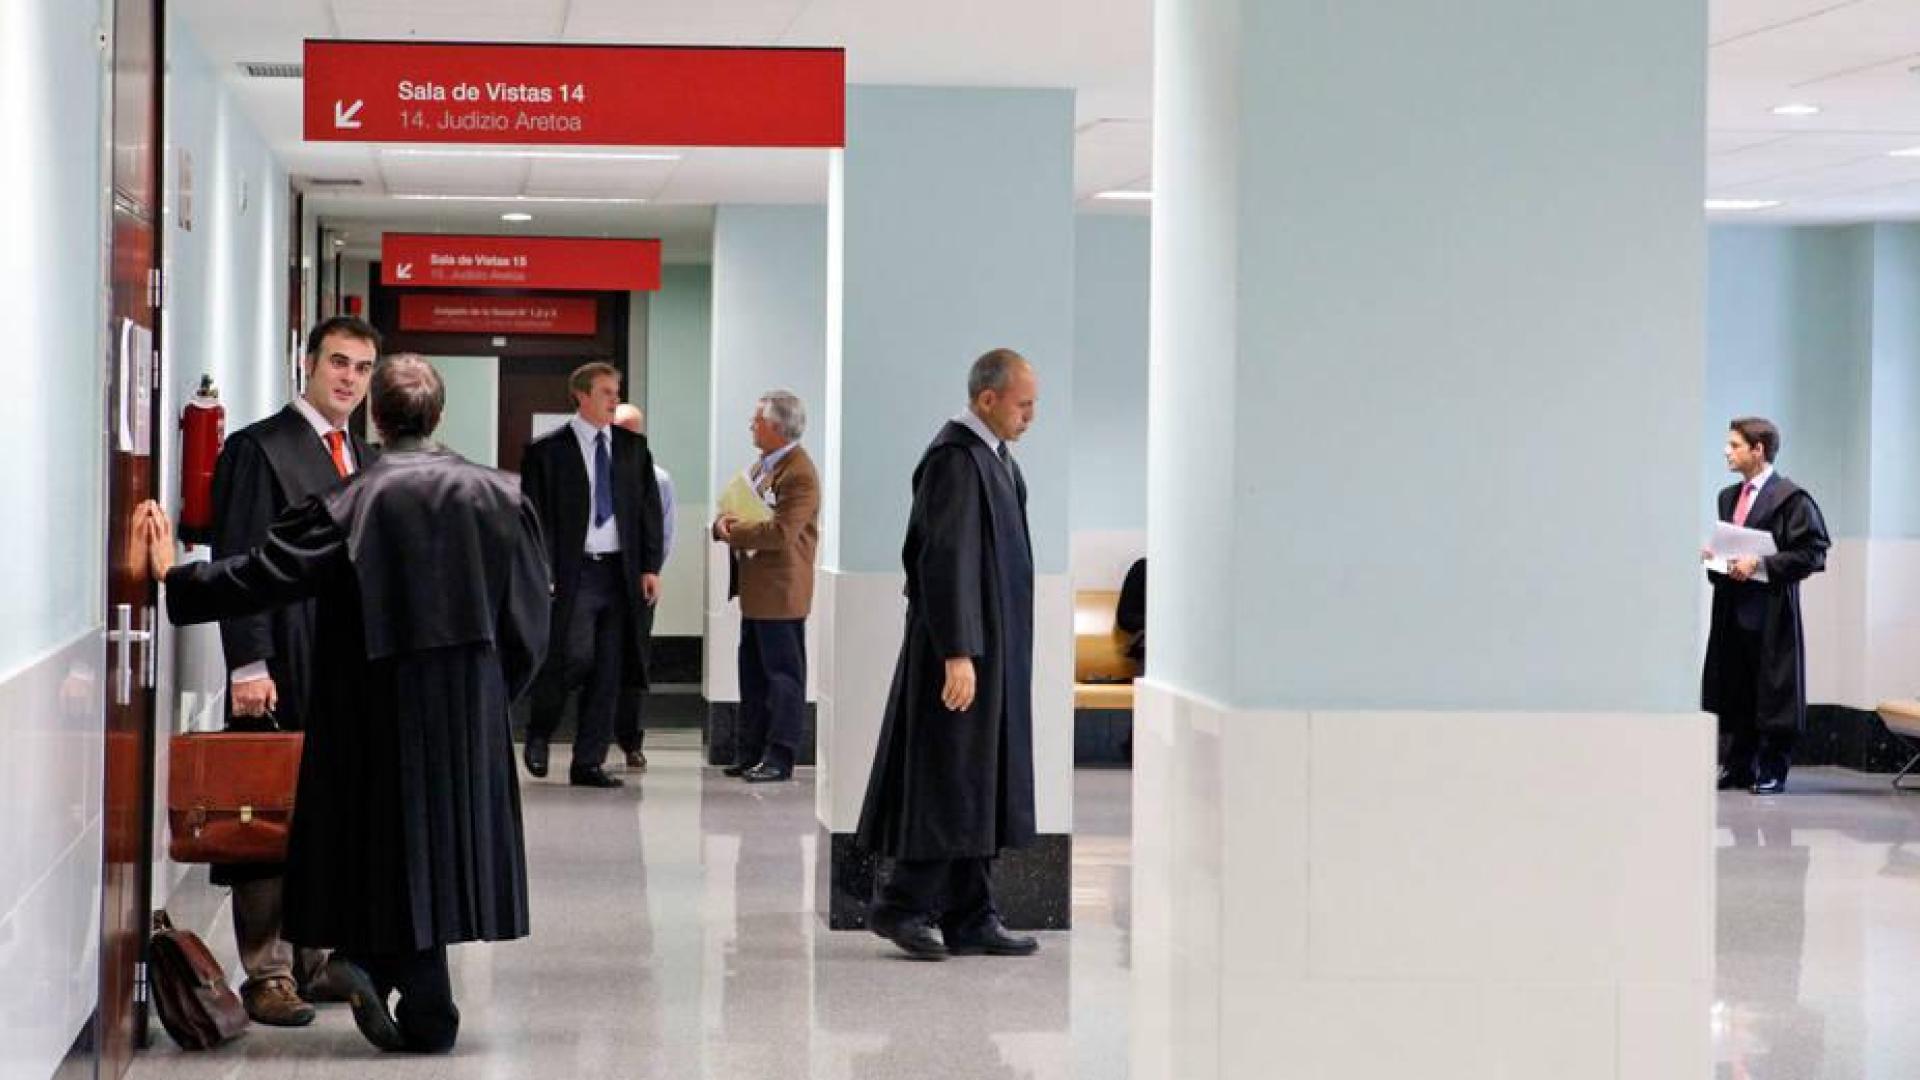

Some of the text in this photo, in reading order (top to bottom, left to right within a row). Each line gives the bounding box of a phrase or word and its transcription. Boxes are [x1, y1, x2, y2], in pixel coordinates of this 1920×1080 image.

[398, 81, 585, 103] Sala de Vistas 14
[399, 110, 582, 132] 14. Judizio Aretoa
[430, 254, 455, 266] Sala
